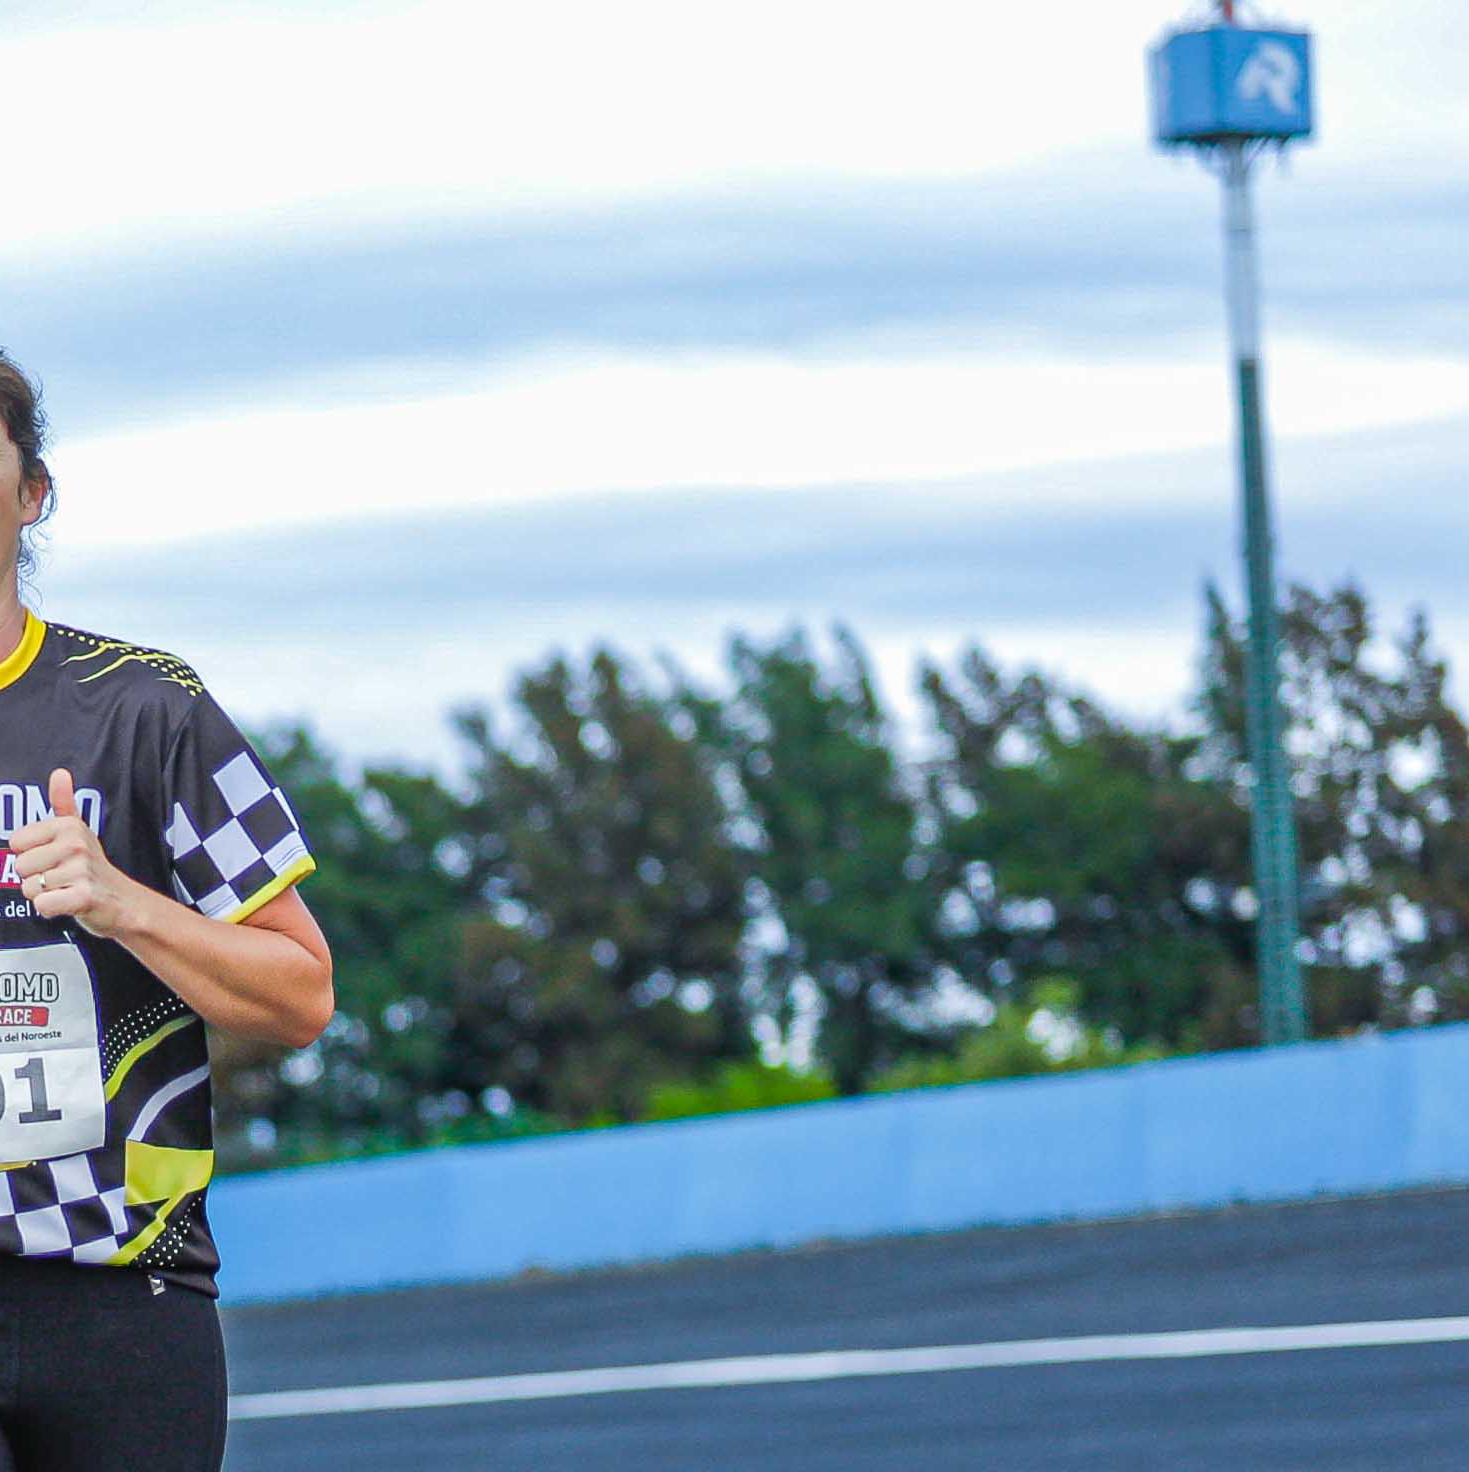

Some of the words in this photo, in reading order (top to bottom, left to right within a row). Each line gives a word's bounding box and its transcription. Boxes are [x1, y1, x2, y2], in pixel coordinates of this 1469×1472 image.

[4, 900, 31, 918] del
[4, 1031, 19, 1043] del
[21, 1029, 63, 1041] Noroeste
